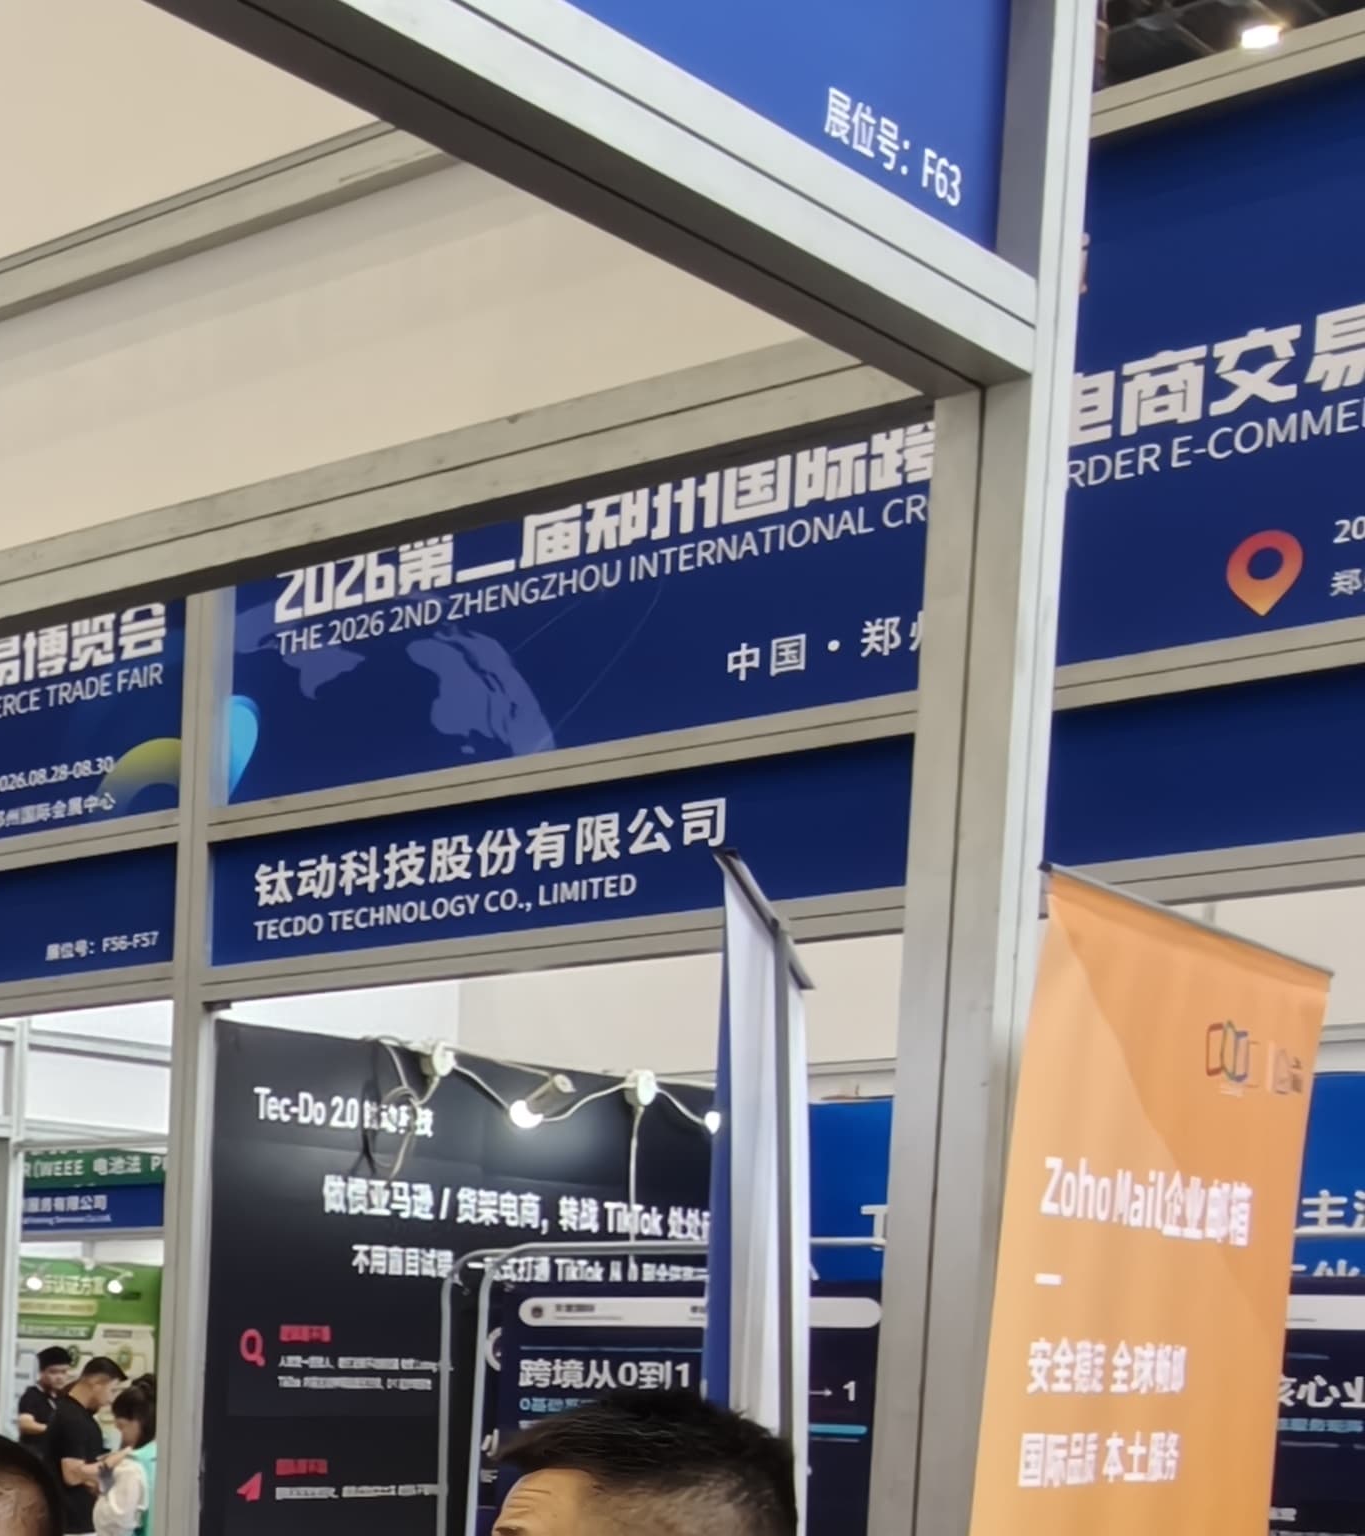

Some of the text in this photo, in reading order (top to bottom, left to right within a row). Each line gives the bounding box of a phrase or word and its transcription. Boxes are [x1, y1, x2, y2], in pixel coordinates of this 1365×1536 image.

[1171, 398, 1365, 467] E-COMME
[276, 494, 928, 656] THE 2026 2ND ZHENGZHOU INTERNATIONAL CR
[1330, 567, 1365, 597] 郑
[46, 675, 112, 706] TRADE
[116, 663, 164, 694] FAIR
[254, 798, 727, 907] 钛动科技股份有限公司
[253, 873, 637, 942] TECDO TECHNOLOGY CO., LIMITED
[253, 1086, 327, 1126] Tec-Do
[322, 1174, 436, 1222] 做惯亚马逊
[603, 1200, 665, 1237] TikTok
[1040, 1156, 1112, 1222] Zoho
[1301, 1188, 1365, 1232] 主
[518, 1358, 691, 1391] 跨境从0到1
